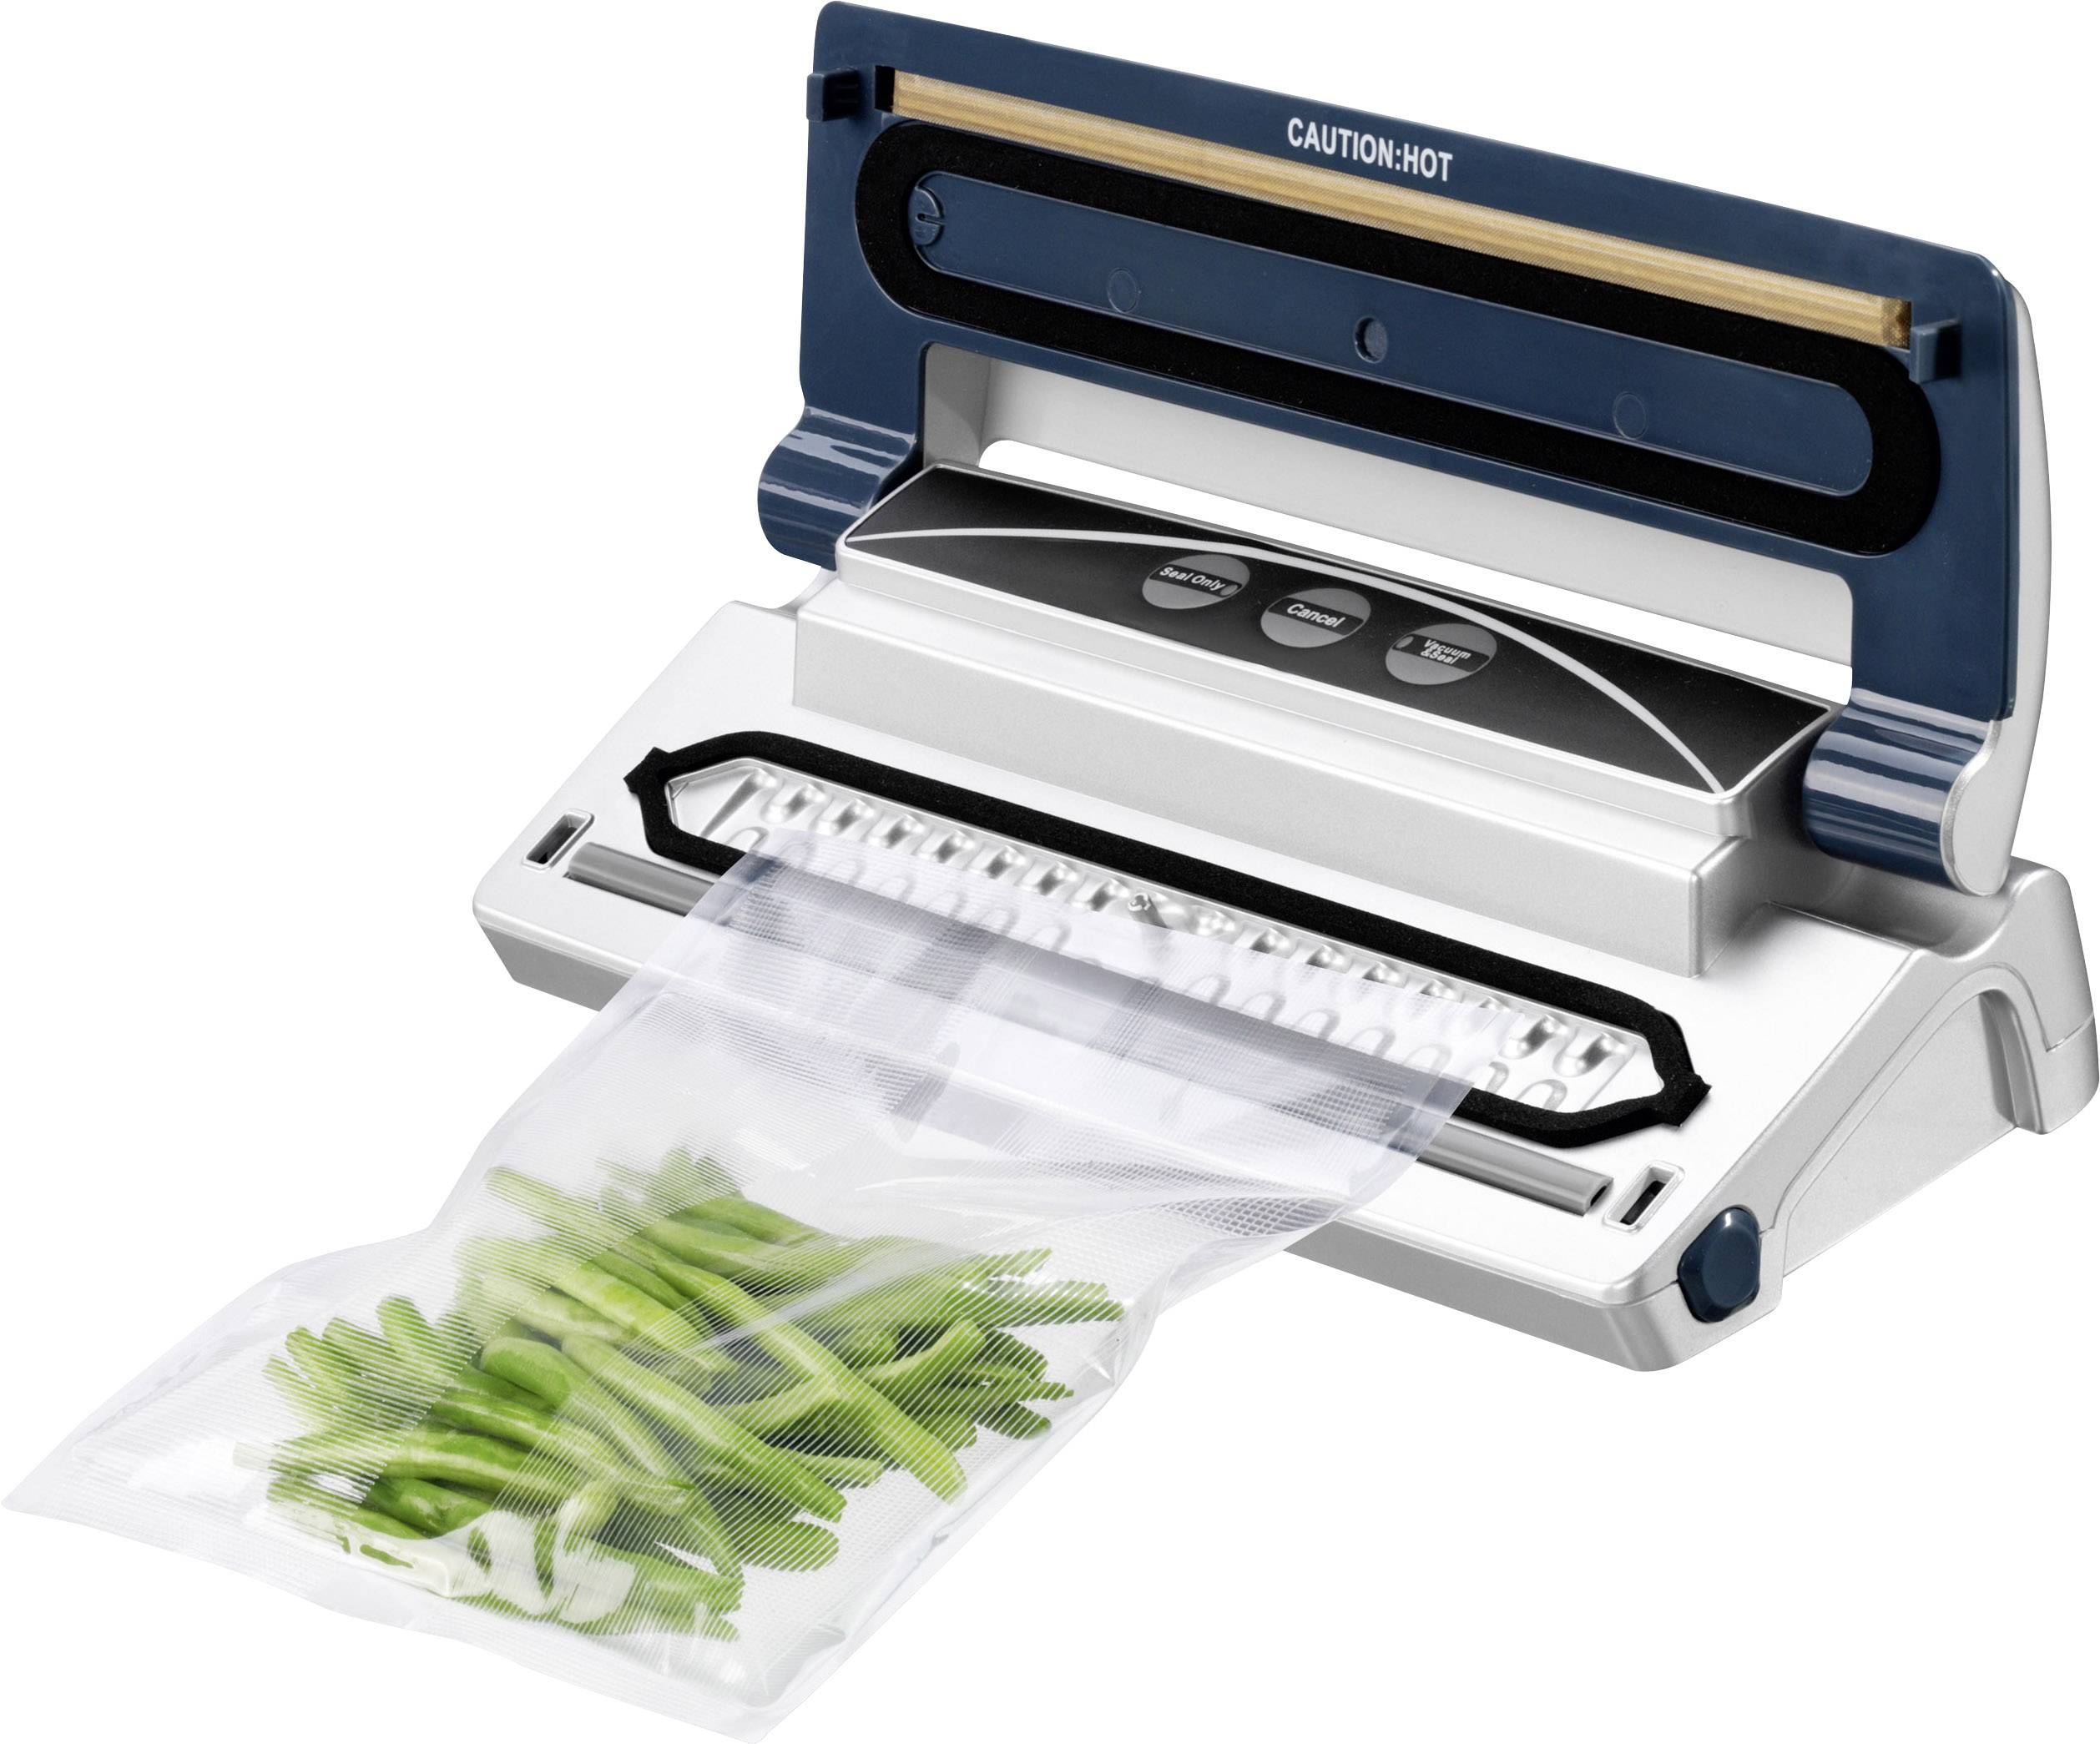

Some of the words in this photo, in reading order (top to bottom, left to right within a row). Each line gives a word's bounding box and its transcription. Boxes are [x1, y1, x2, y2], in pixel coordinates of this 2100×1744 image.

[1287, 117, 1453, 182] CAUTION:HOT
[1159, 567, 1194, 581] Seal
[1191, 575, 1226, 591] Only
[1287, 603, 1346, 628] Cancel
[1421, 648, 1460, 664] &Seal
[1424, 639, 1472, 659] Vacuum
